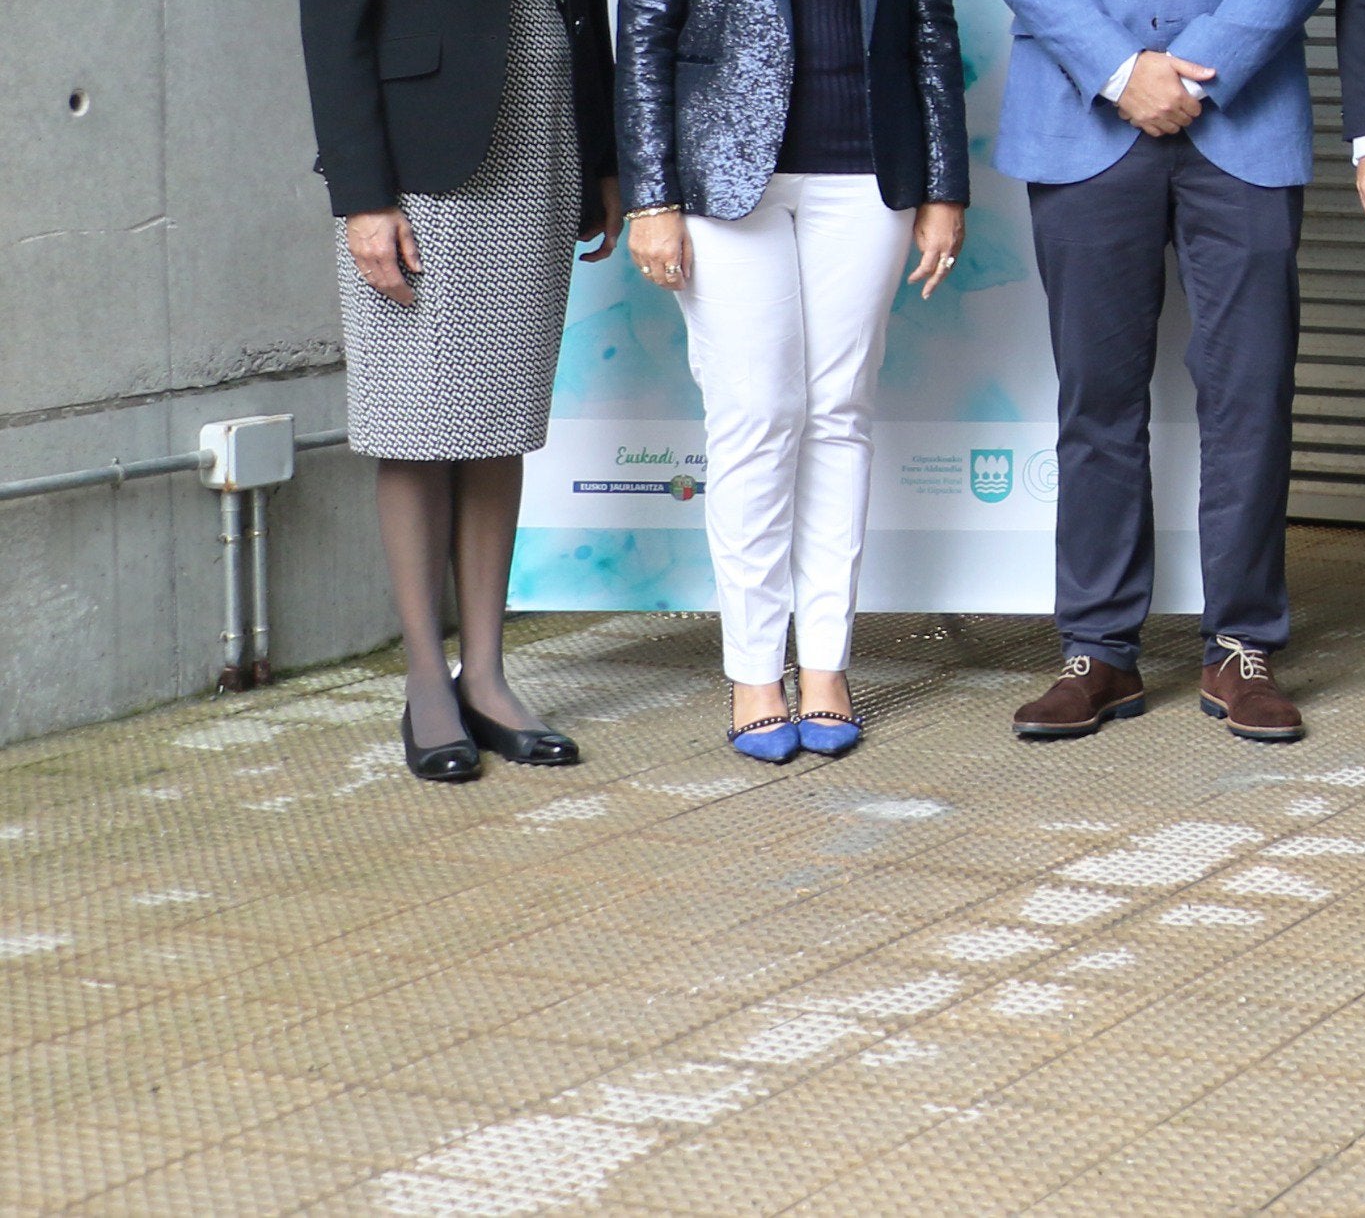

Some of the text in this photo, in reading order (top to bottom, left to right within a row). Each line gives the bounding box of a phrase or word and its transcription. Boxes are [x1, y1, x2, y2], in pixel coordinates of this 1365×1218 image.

[615, 445, 680, 469] Euskadi,
[580, 483, 665, 492] EUSKO JAURLARITZA
